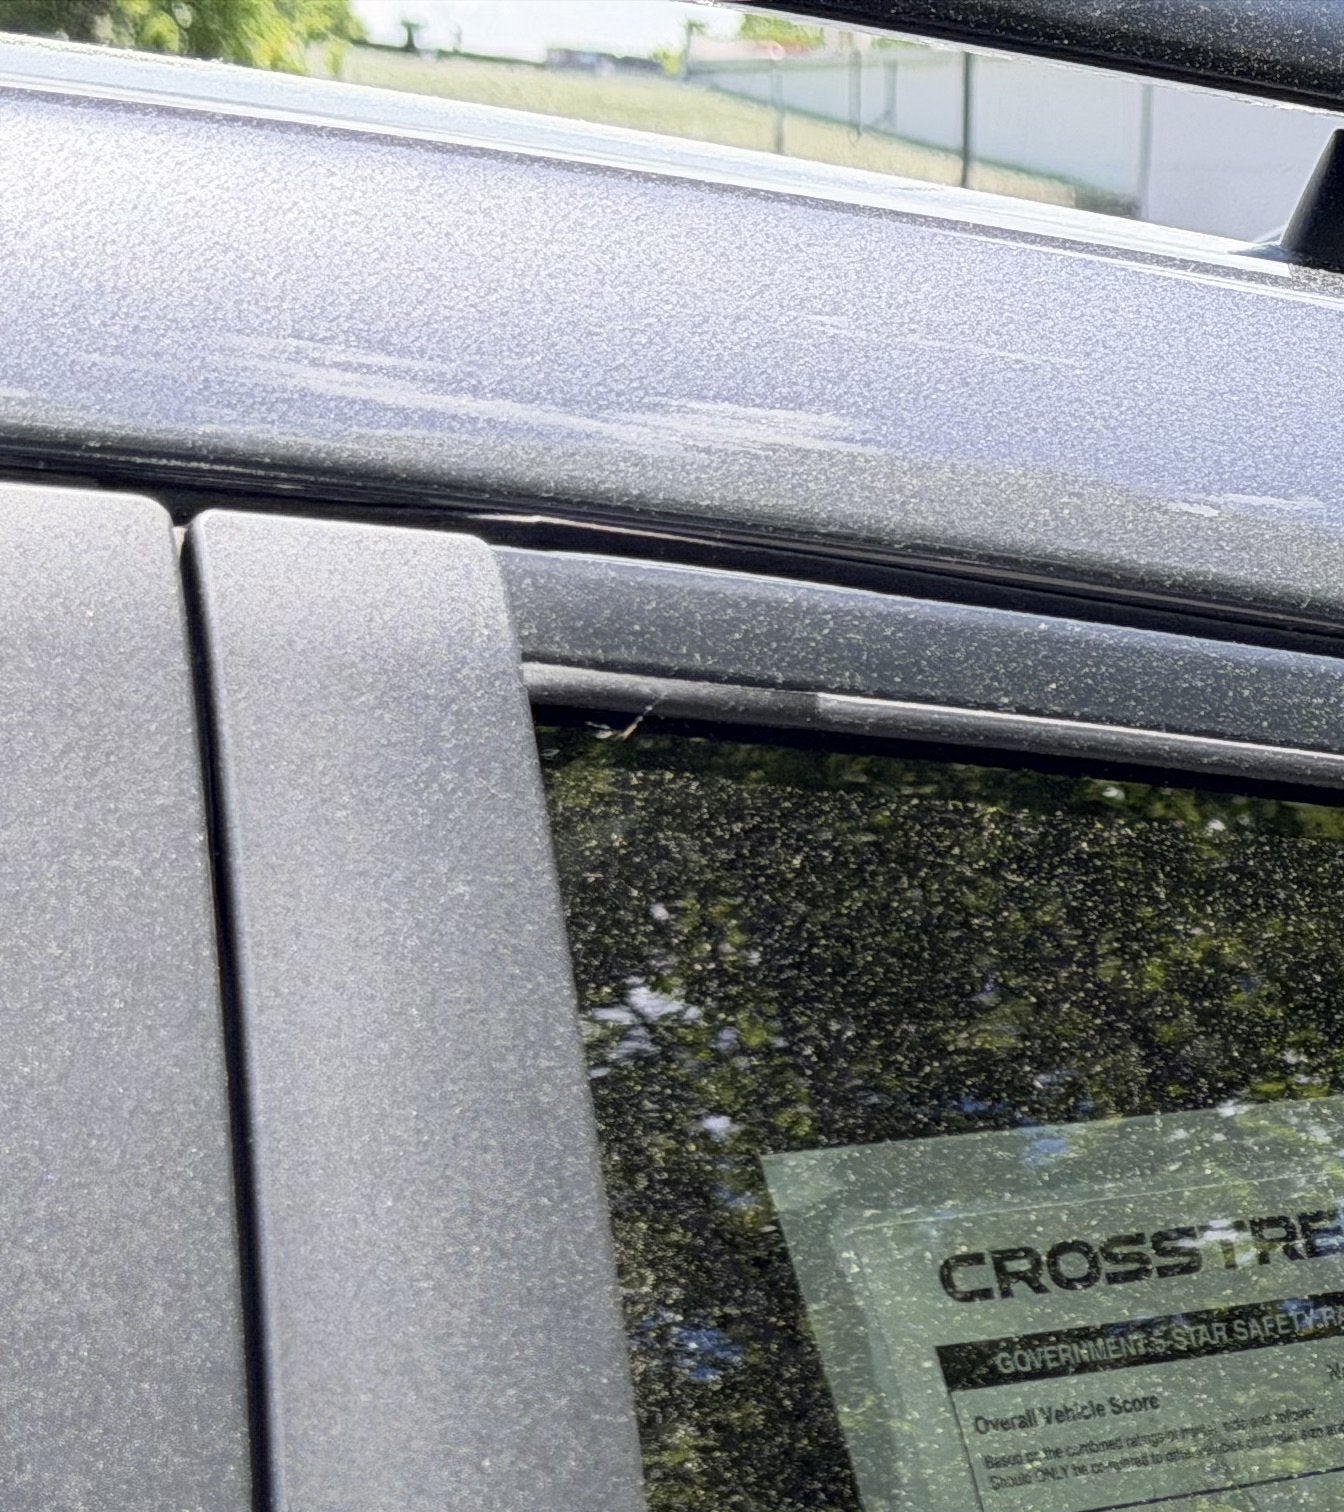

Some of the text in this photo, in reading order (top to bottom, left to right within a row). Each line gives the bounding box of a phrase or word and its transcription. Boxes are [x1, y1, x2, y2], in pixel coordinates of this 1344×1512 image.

[993, 1334, 1149, 1375] GOVERNMENT
[1231, 1309, 1321, 1340] SAFETY
[972, 1391, 1160, 1437] Overall Vehicle Score
